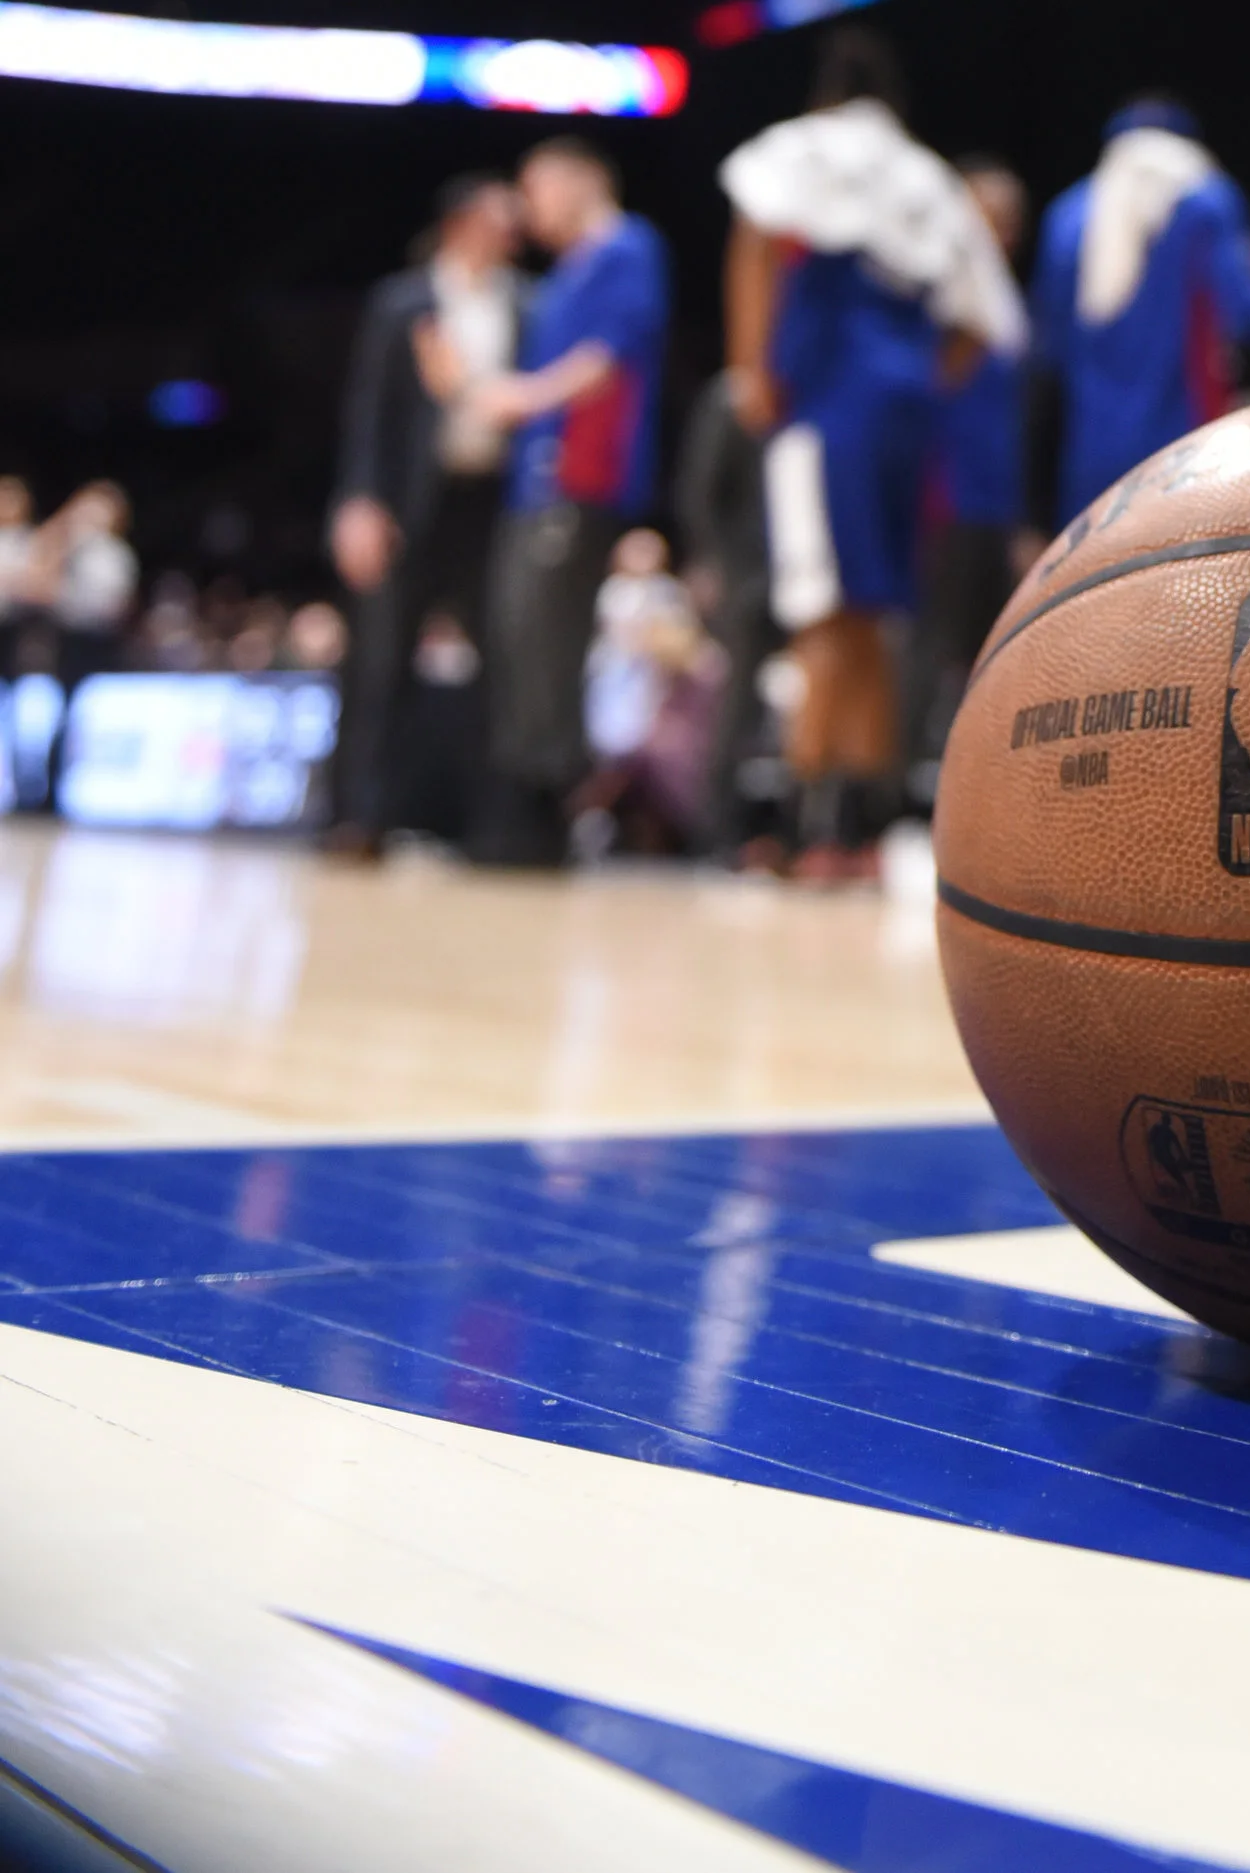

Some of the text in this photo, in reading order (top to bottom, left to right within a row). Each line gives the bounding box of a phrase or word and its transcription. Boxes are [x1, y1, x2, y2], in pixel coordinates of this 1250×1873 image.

[1010, 684, 1192, 750] OFFICIAL GAME BALL
